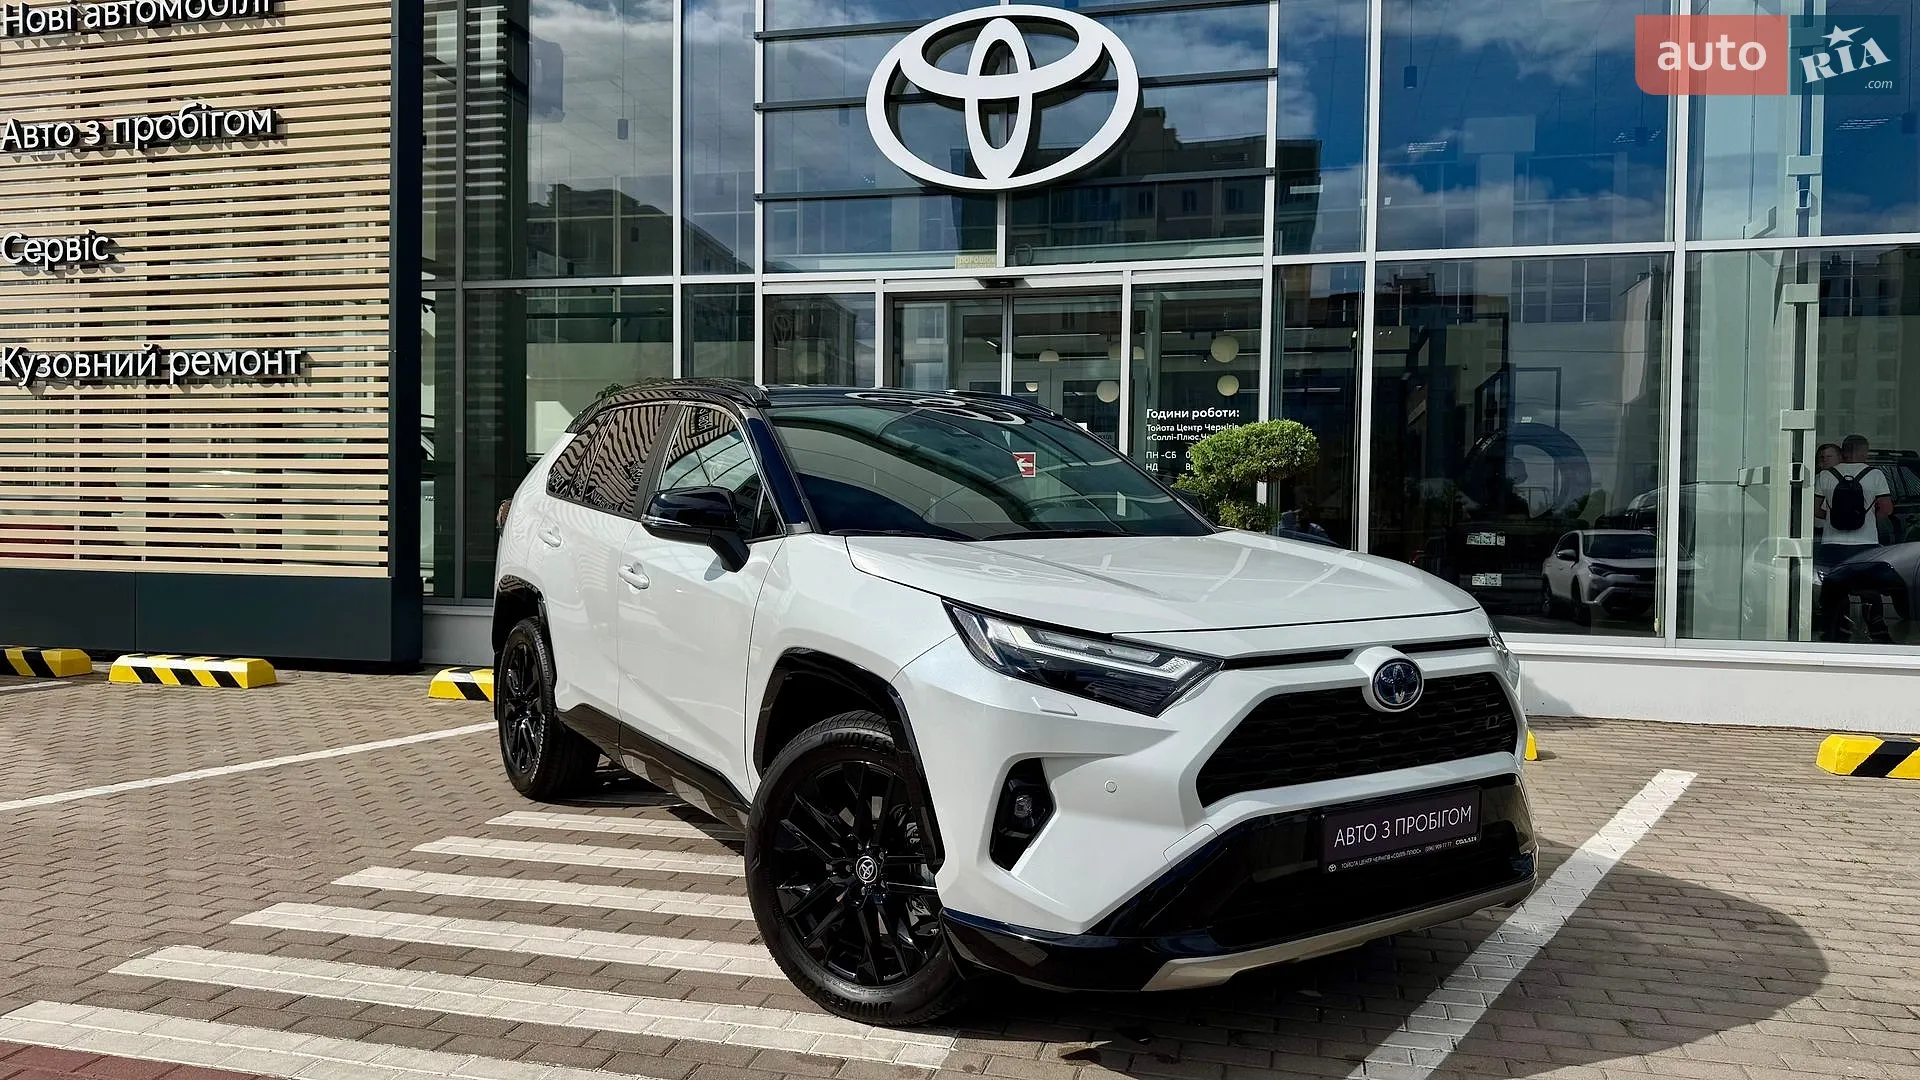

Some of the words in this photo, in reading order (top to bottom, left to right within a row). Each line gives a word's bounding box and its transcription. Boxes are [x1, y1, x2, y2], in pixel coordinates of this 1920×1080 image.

[2, 0, 72, 36] Нові
[1, 118, 74, 151] Авто
[84, 119, 102, 145] з
[112, 102, 274, 151] пробігом
[1, 229, 110, 271] Сервіс
[1, 343, 157, 386] Кузовний
[169, 348, 302, 384] ремонт
[1146, 408, 1189, 420] Години
[1192, 407, 1240, 420] роботи:
[1176, 424, 1203, 433] Центр
[1145, 463, 1159, 472] НД
[1333, 823, 1377, 848] АВТО
[1395, 805, 1472, 837] ПРОБІГОМ
